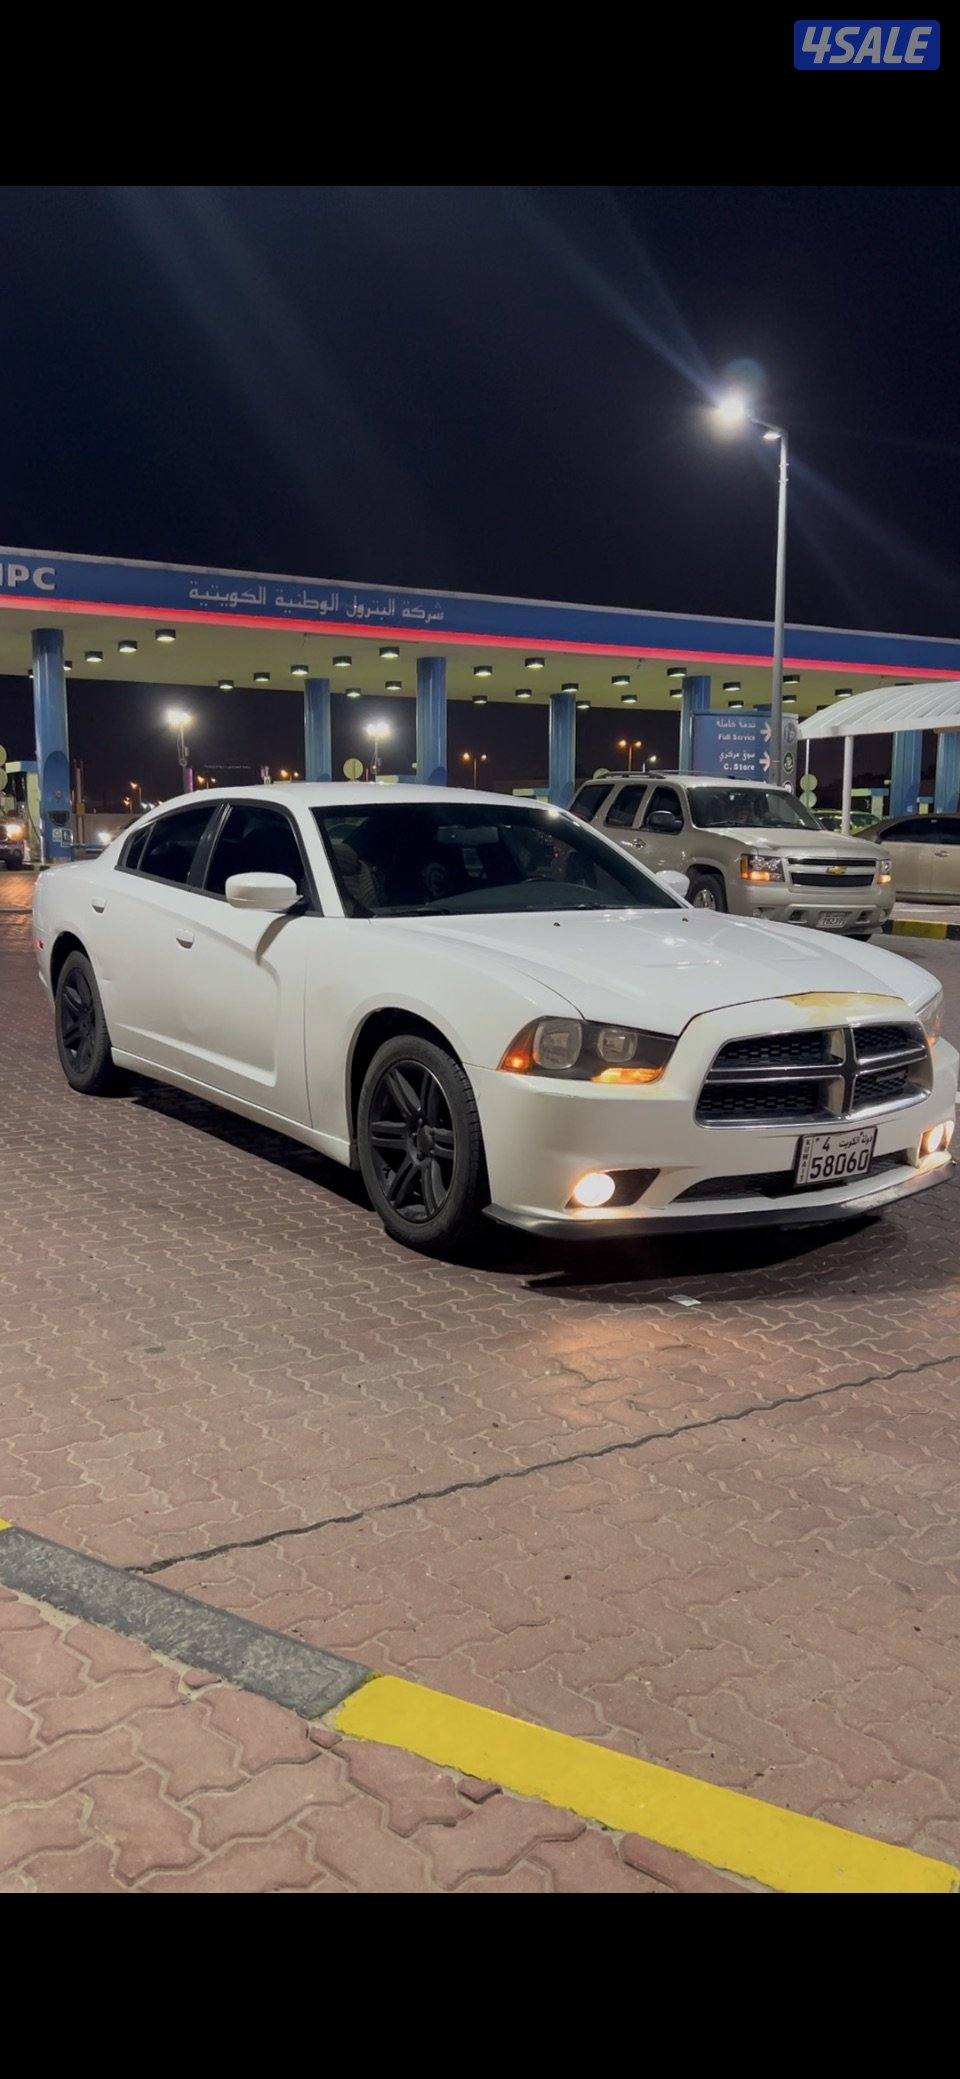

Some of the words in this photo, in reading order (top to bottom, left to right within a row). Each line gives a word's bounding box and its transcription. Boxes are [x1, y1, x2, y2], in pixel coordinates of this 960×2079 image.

[0, 563, 56, 591] PC
[189, 580, 266, 607] الكويتية
[275, 588, 339, 616] الوطنية
[346, 595, 396, 621] البترول
[402, 600, 444, 624] شركة
[718, 733, 731, 741] Full
[732, 733, 756, 741] Service
[734, 763, 755, 771] Store
[822, 1136, 831, 1152] 4
[810, 1149, 869, 1180] 58060
